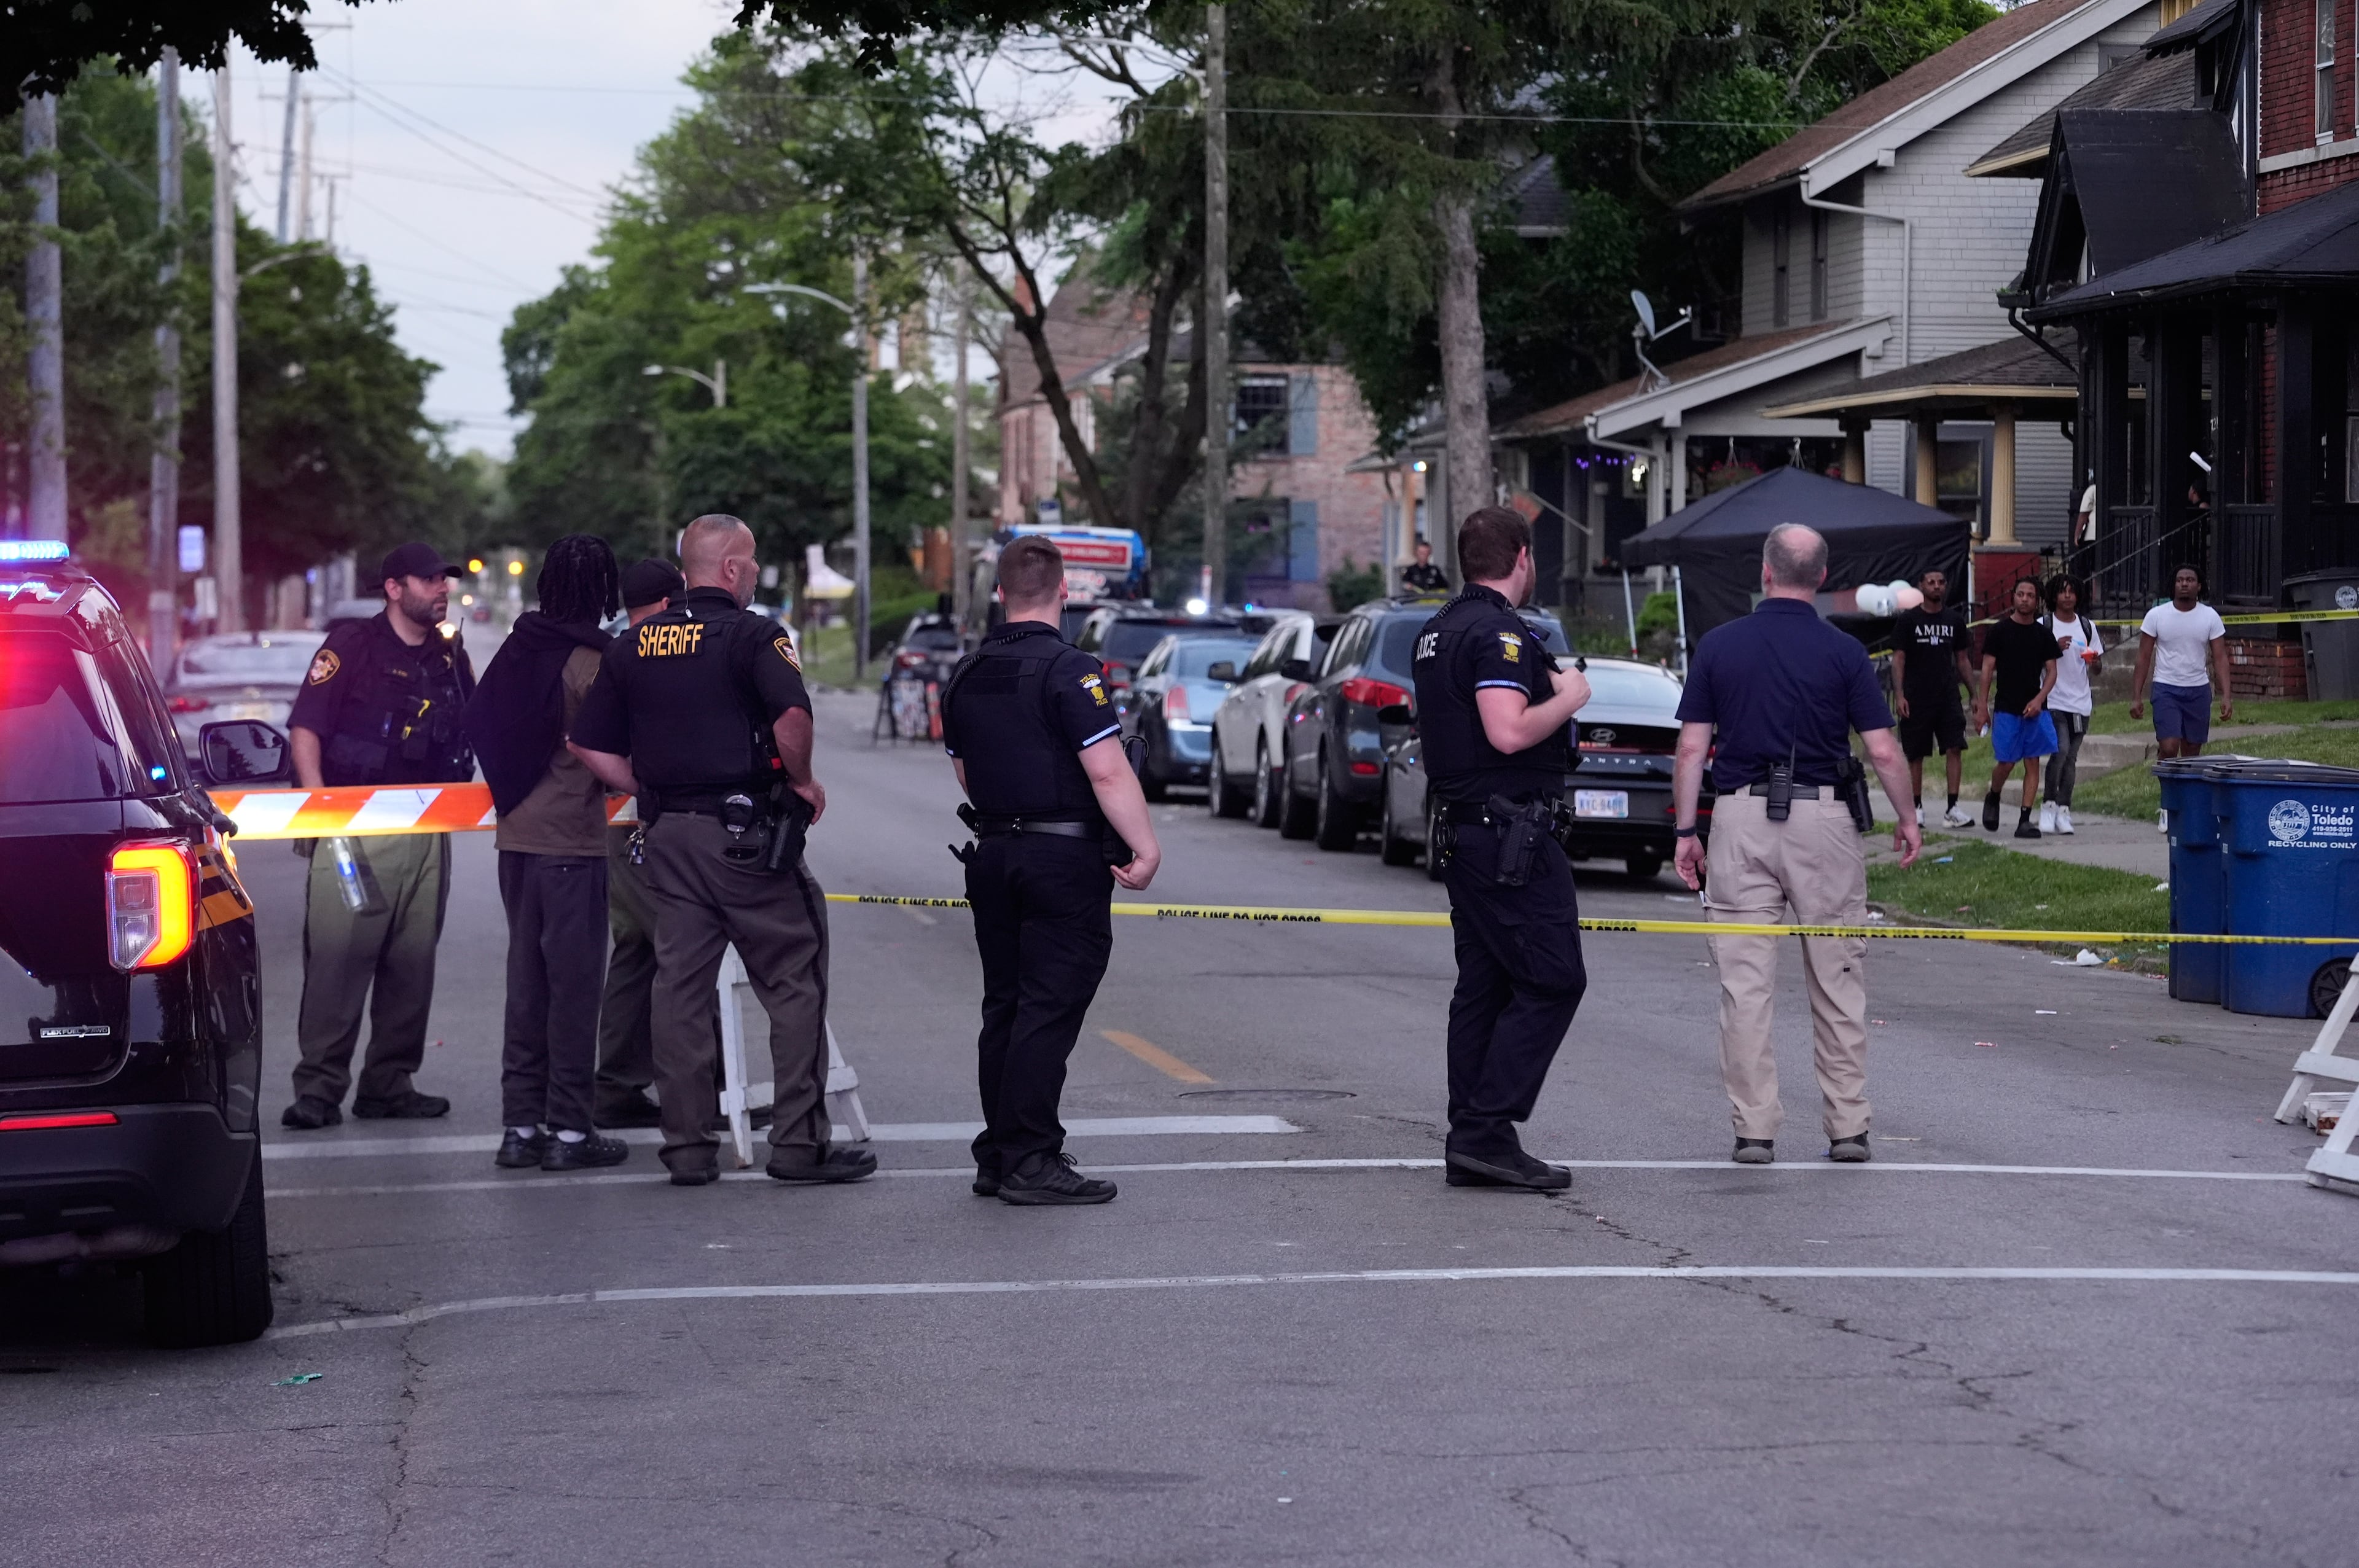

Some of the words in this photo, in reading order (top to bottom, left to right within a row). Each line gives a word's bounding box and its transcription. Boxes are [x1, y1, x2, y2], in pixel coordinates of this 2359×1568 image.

[1915, 624, 1954, 637] AMIRI
[638, 623, 704, 657] SHERIFF
[1499, 632, 1522, 643] TOLEDO
[1415, 633, 1439, 661] OLICE
[1503, 653, 1519, 663] POLICE
[1079, 673, 1099, 684] TOLEDO
[1095, 697, 1108, 707] POLICE
[1582, 756, 1652, 766] ANTRA
[2312, 805, 2336, 814] City
[2312, 814, 2353, 825] Toledo
